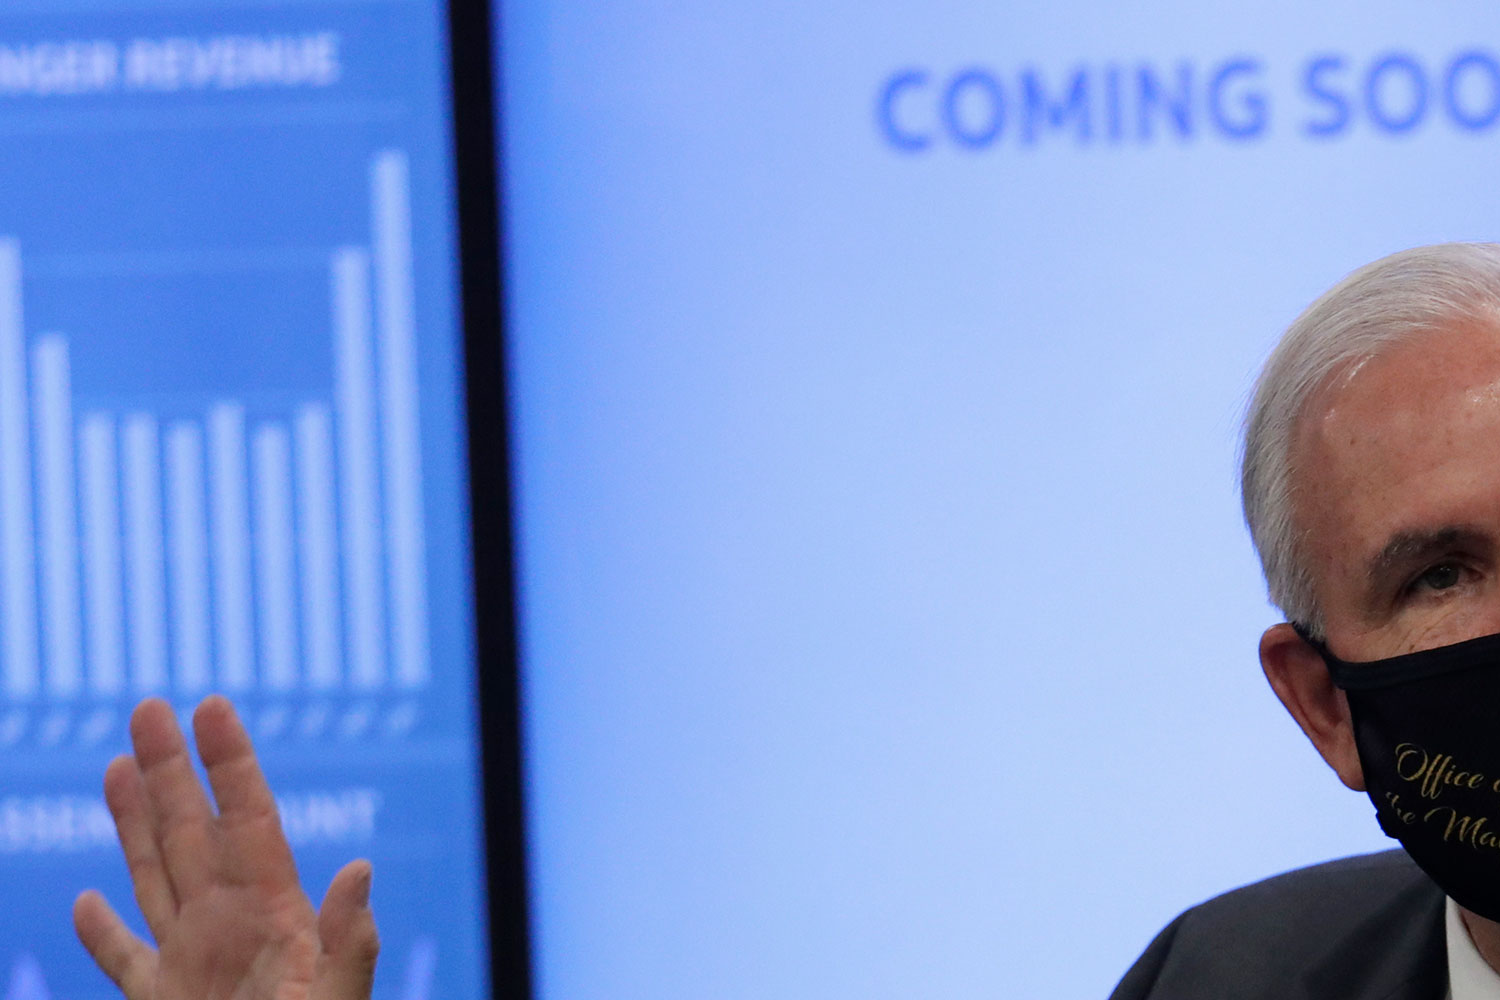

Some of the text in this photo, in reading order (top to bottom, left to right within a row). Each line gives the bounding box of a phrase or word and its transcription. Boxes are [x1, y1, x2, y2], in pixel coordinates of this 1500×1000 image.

[125, 33, 339, 90] REVENUE
[874, 57, 1268, 152] COMING
[1395, 742, 1485, 799] Office
